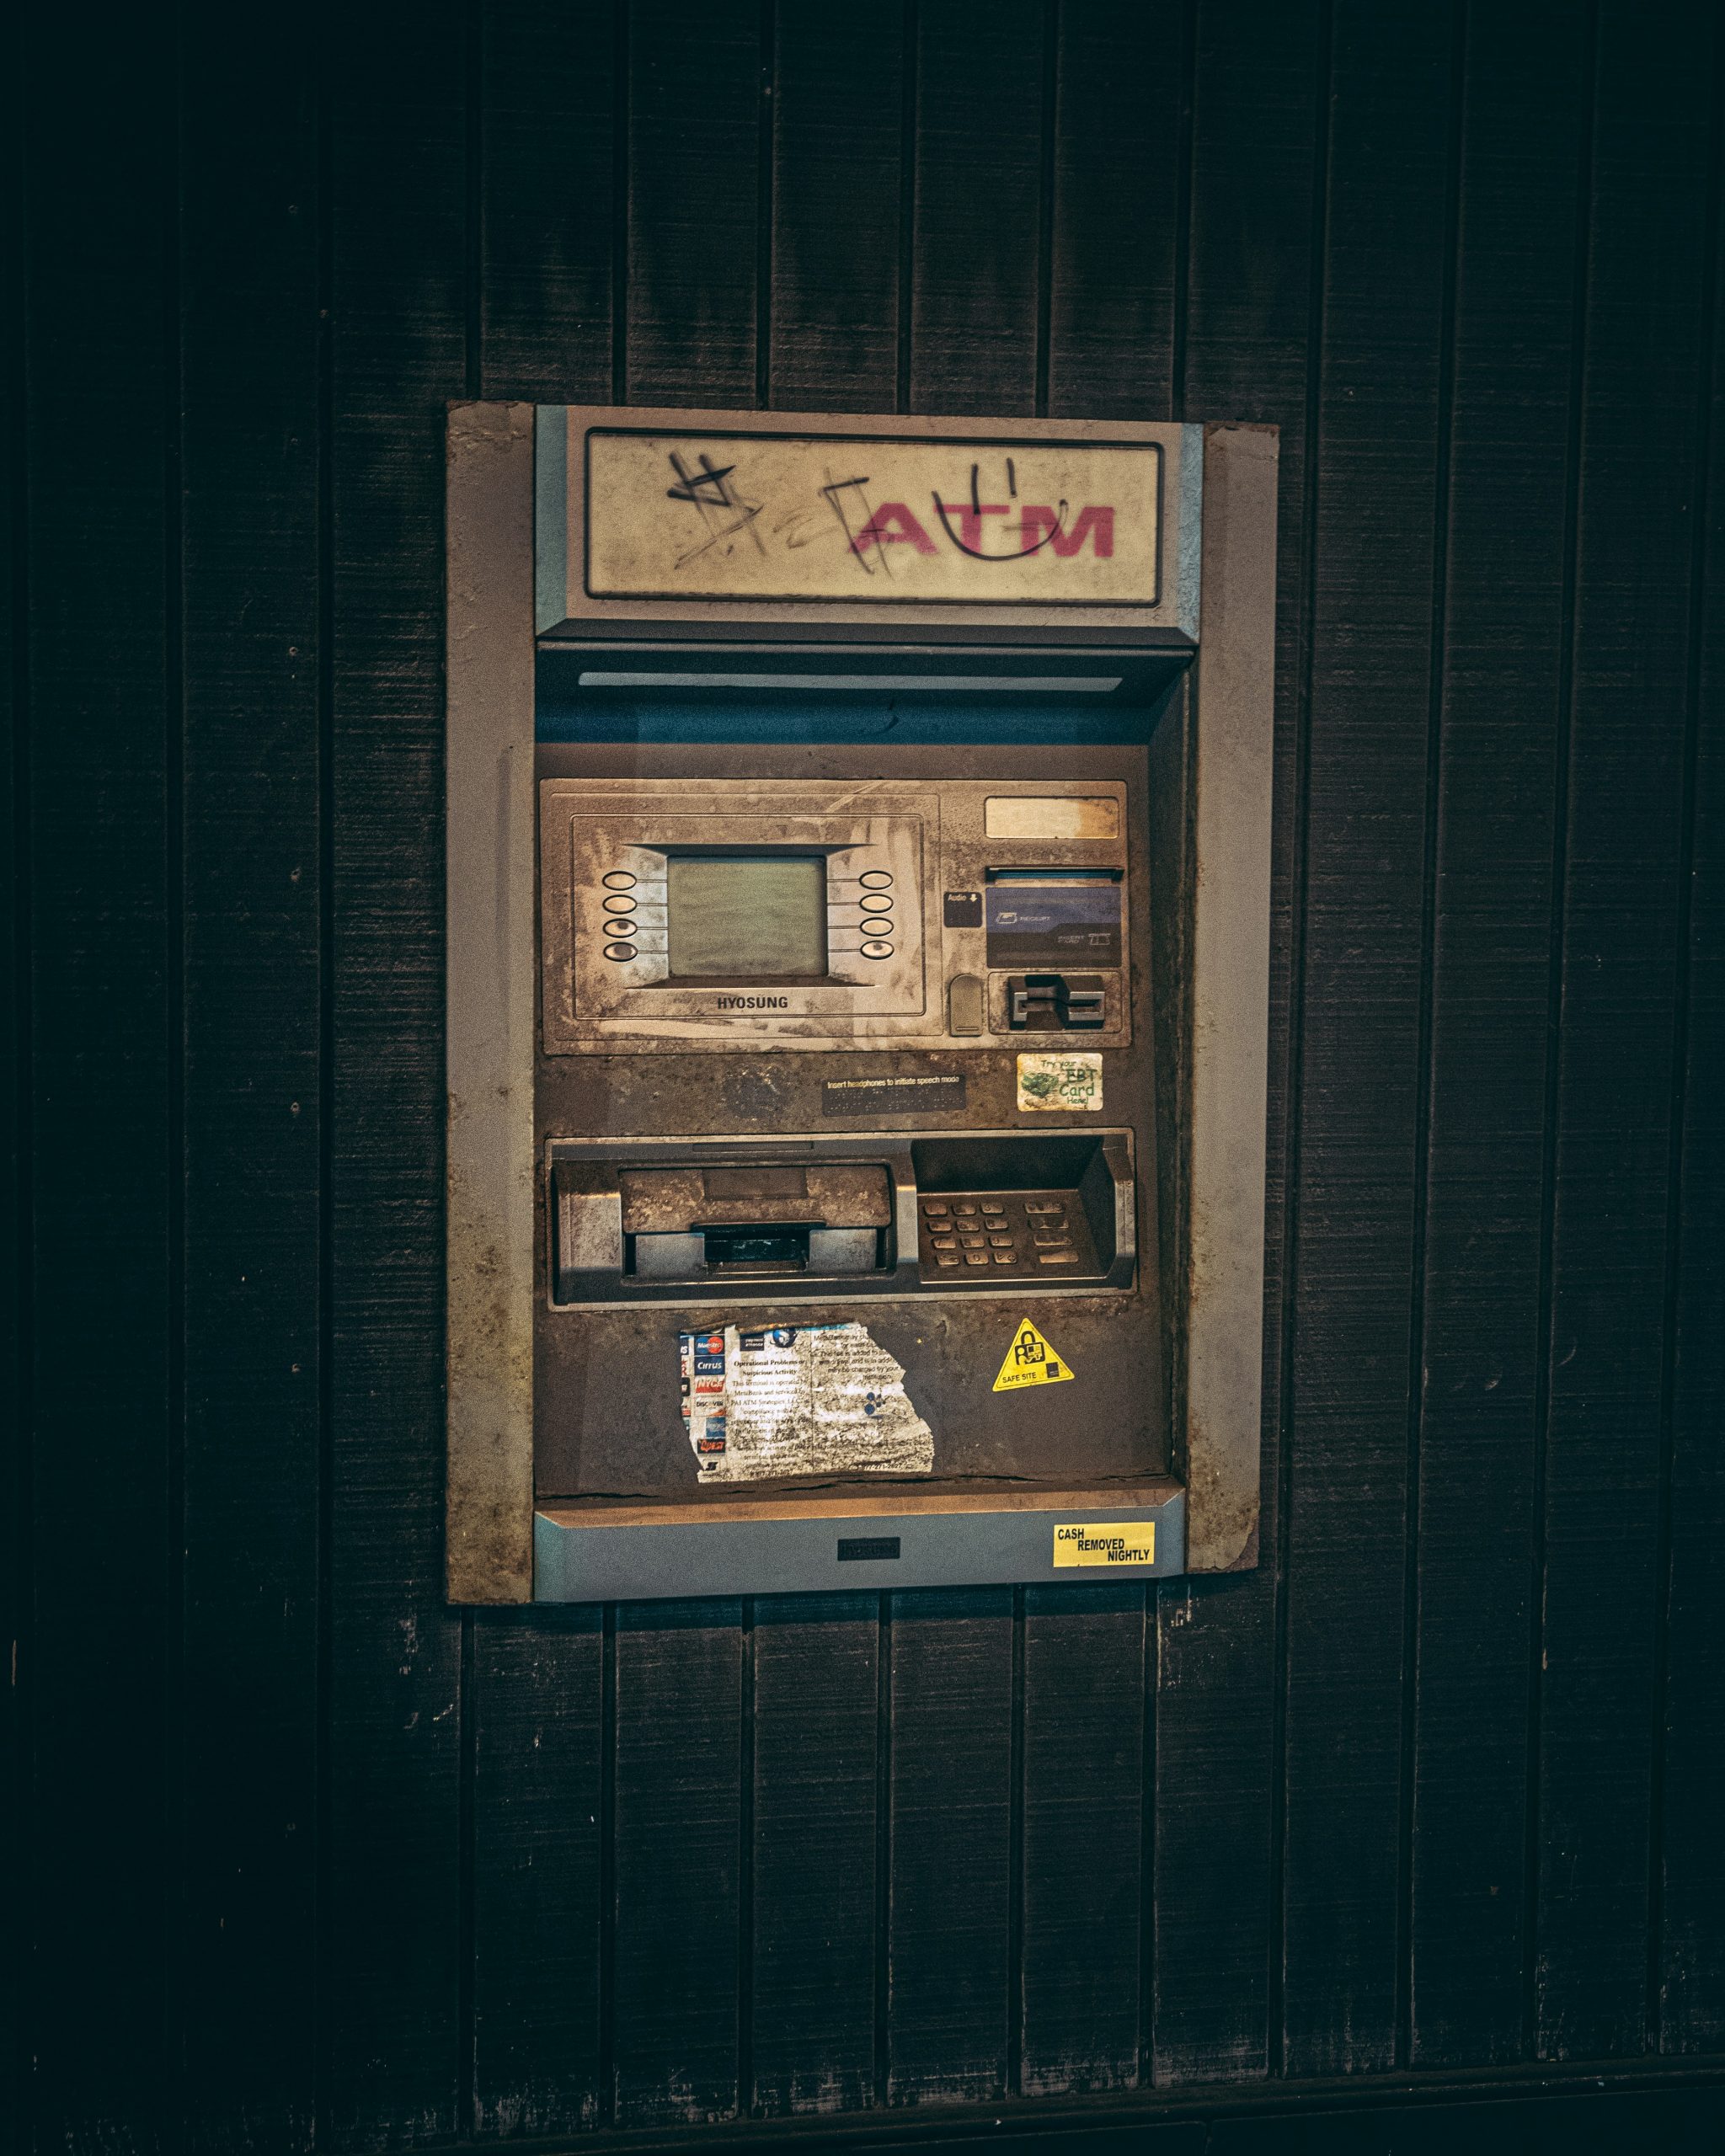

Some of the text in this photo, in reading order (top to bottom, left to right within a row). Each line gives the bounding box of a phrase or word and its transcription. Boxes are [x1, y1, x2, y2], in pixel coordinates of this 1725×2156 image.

[848, 503, 1114, 558] ATM
[948, 894, 967, 902] Audio
[717, 996, 788, 1009] HYOSUNG
[1041, 1059, 1077, 1069] Try your
[827, 1081, 846, 1089] Insert
[847, 1080, 886, 1089] headphones
[887, 1078, 894, 1086] to
[895, 1077, 916, 1086] initiate
[916, 1075, 941, 1086] speech
[1066, 1068, 1097, 1083] EBT
[1059, 1082, 1095, 1097] Card
[1002, 1372, 1037, 1384] SAFE SITE
[1058, 1529, 1085, 1540] CASH
[1077, 1538, 1124, 1551] REMOVED
[1108, 1549, 1150, 1561] NIGHTLY
